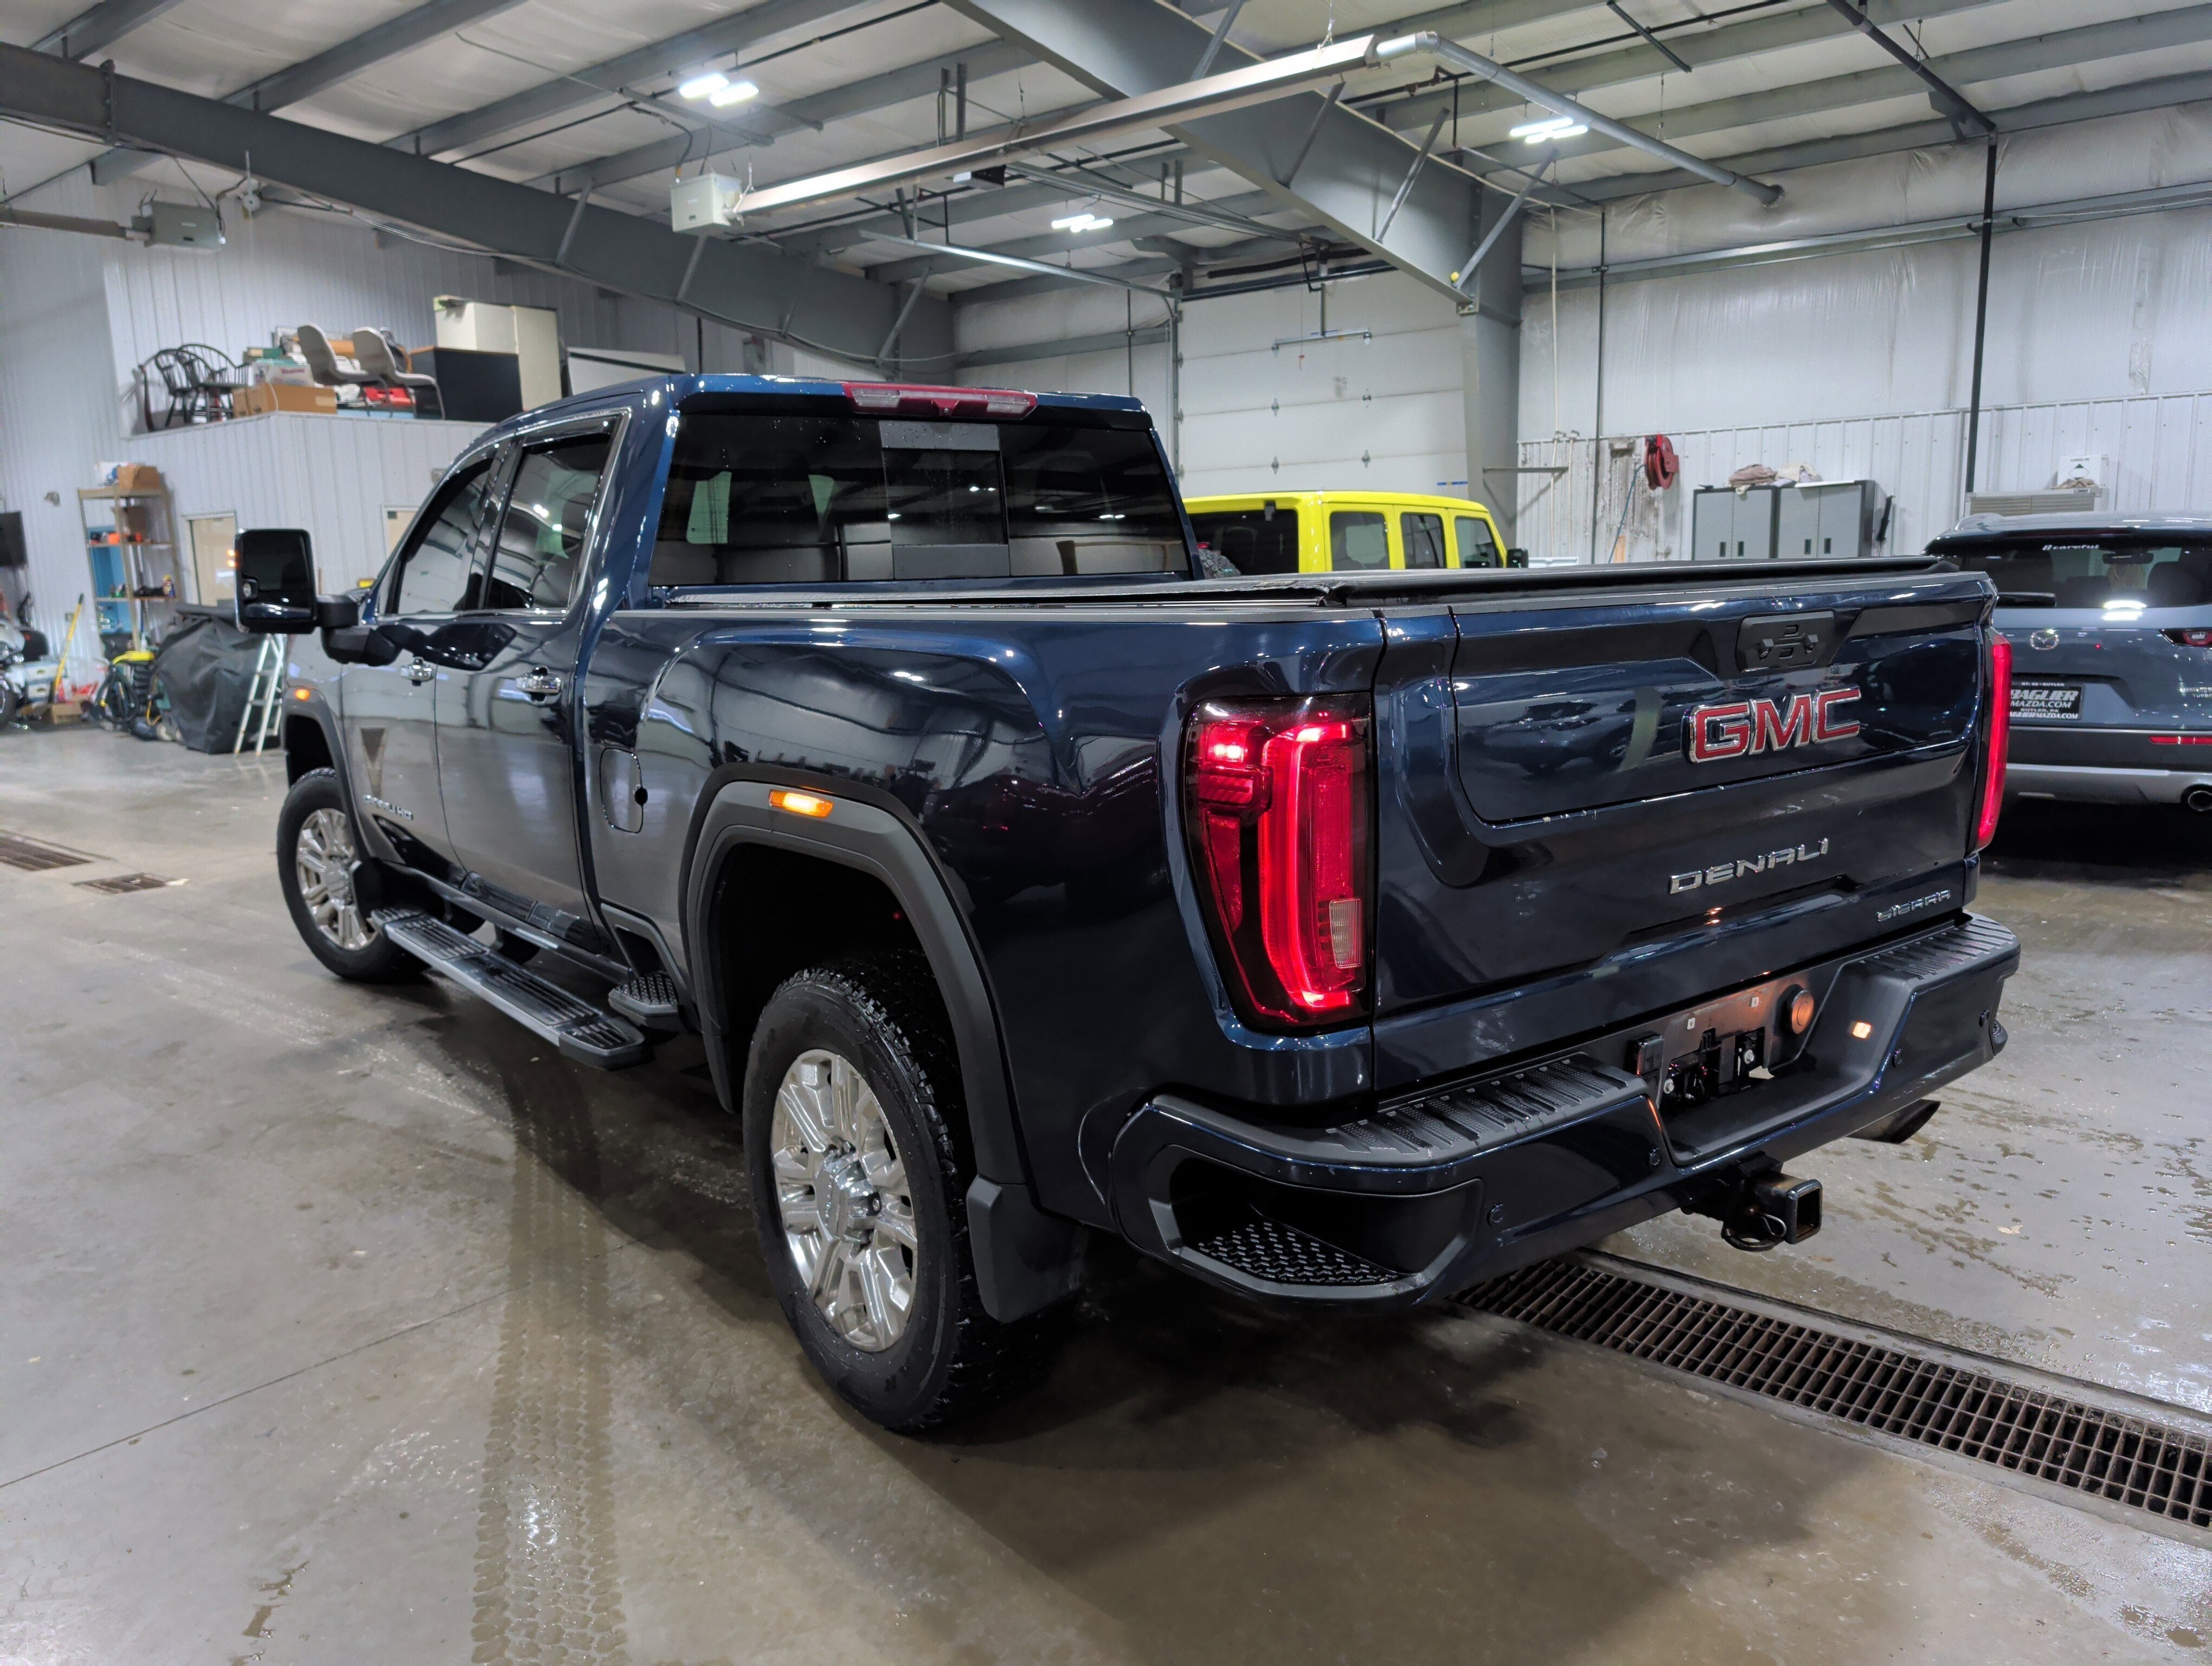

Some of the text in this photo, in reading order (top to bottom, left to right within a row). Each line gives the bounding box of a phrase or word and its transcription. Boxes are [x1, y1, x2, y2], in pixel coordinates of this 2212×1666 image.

[1689, 685, 1861, 762] GMC
[2010, 700, 2072, 708] MAZDA.COM
[1669, 838, 1829, 894] DENALI
[1876, 889, 1951, 922] SIERRA
